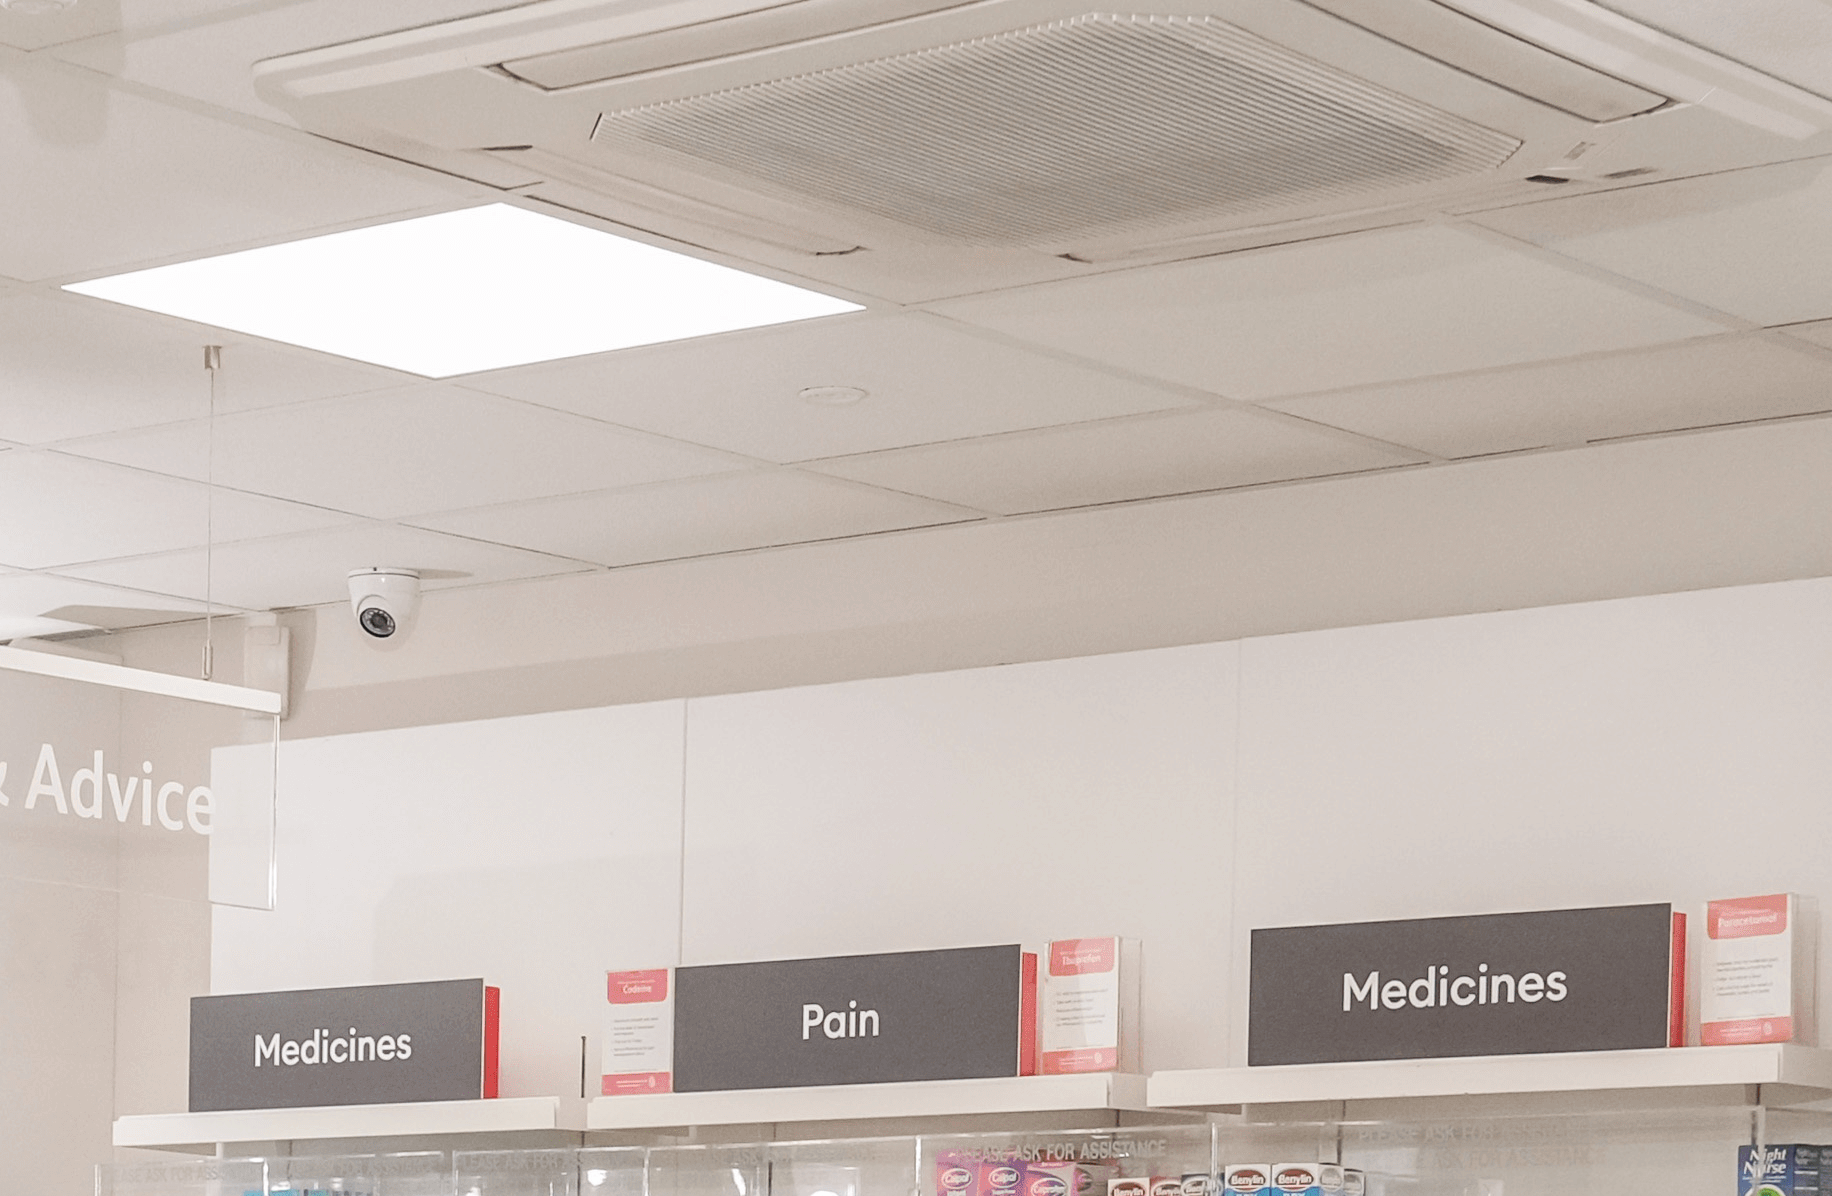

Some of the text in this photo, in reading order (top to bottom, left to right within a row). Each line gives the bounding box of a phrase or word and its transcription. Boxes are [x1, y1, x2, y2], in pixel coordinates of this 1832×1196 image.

[23, 742, 217, 836] Advice
[1341, 962, 1568, 1013] Medicines
[801, 1001, 880, 1041] Pain
[253, 1026, 412, 1067] Medicines
[1231, 1174, 1265, 1186] Benylin
[1278, 1174, 1311, 1186] Benylin
